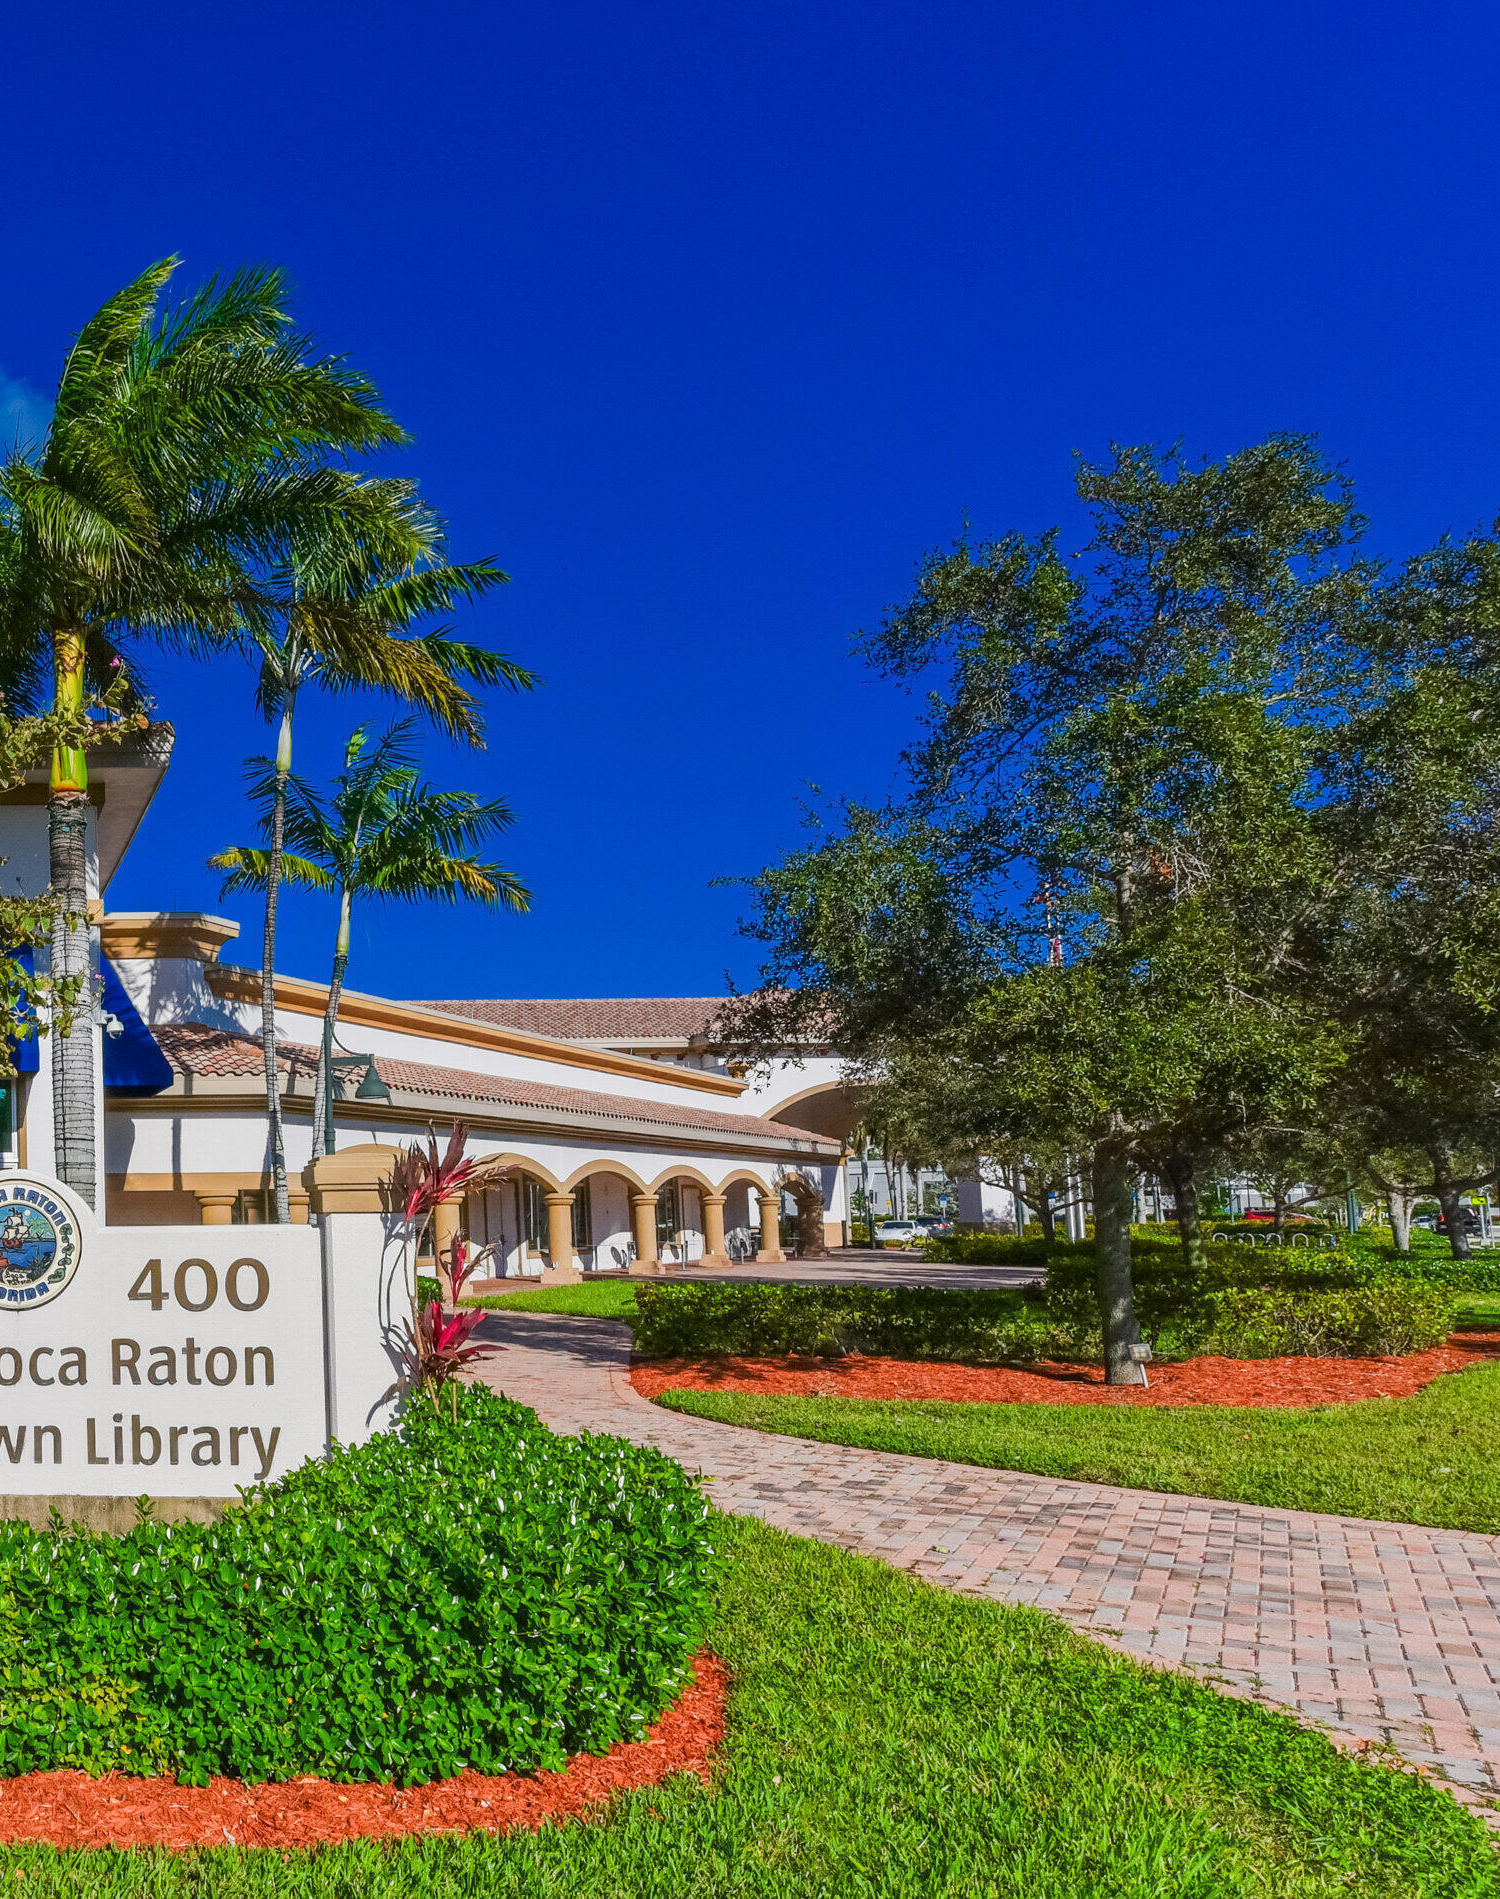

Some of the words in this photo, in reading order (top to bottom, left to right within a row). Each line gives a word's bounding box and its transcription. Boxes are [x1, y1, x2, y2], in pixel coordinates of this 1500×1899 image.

[13, 1187, 67, 1226] RATON
[127, 1257, 270, 1312] 400
[111, 1337, 275, 1387] Raton
[86, 1412, 281, 1481] Library
